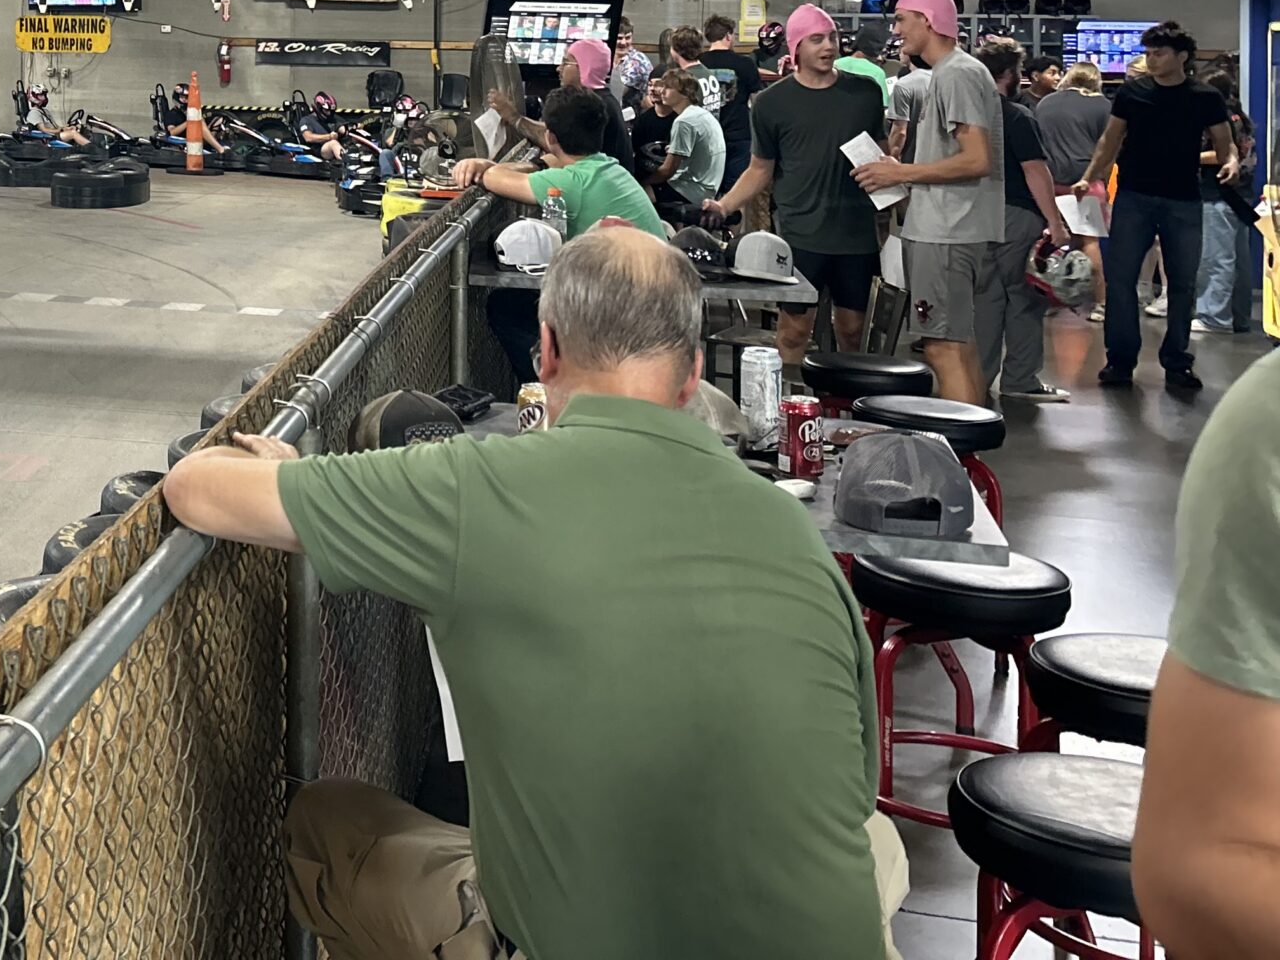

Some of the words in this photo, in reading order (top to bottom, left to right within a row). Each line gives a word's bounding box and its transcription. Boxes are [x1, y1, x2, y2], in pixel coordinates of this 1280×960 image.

[19, 17, 49, 33] FINAL
[53, 18, 106, 34] WARNING
[31, 38, 46, 50] NO
[48, 38, 93, 52] BUMPING
[318, 43, 381, 57] Racing
[698, 75, 720, 97] DO
